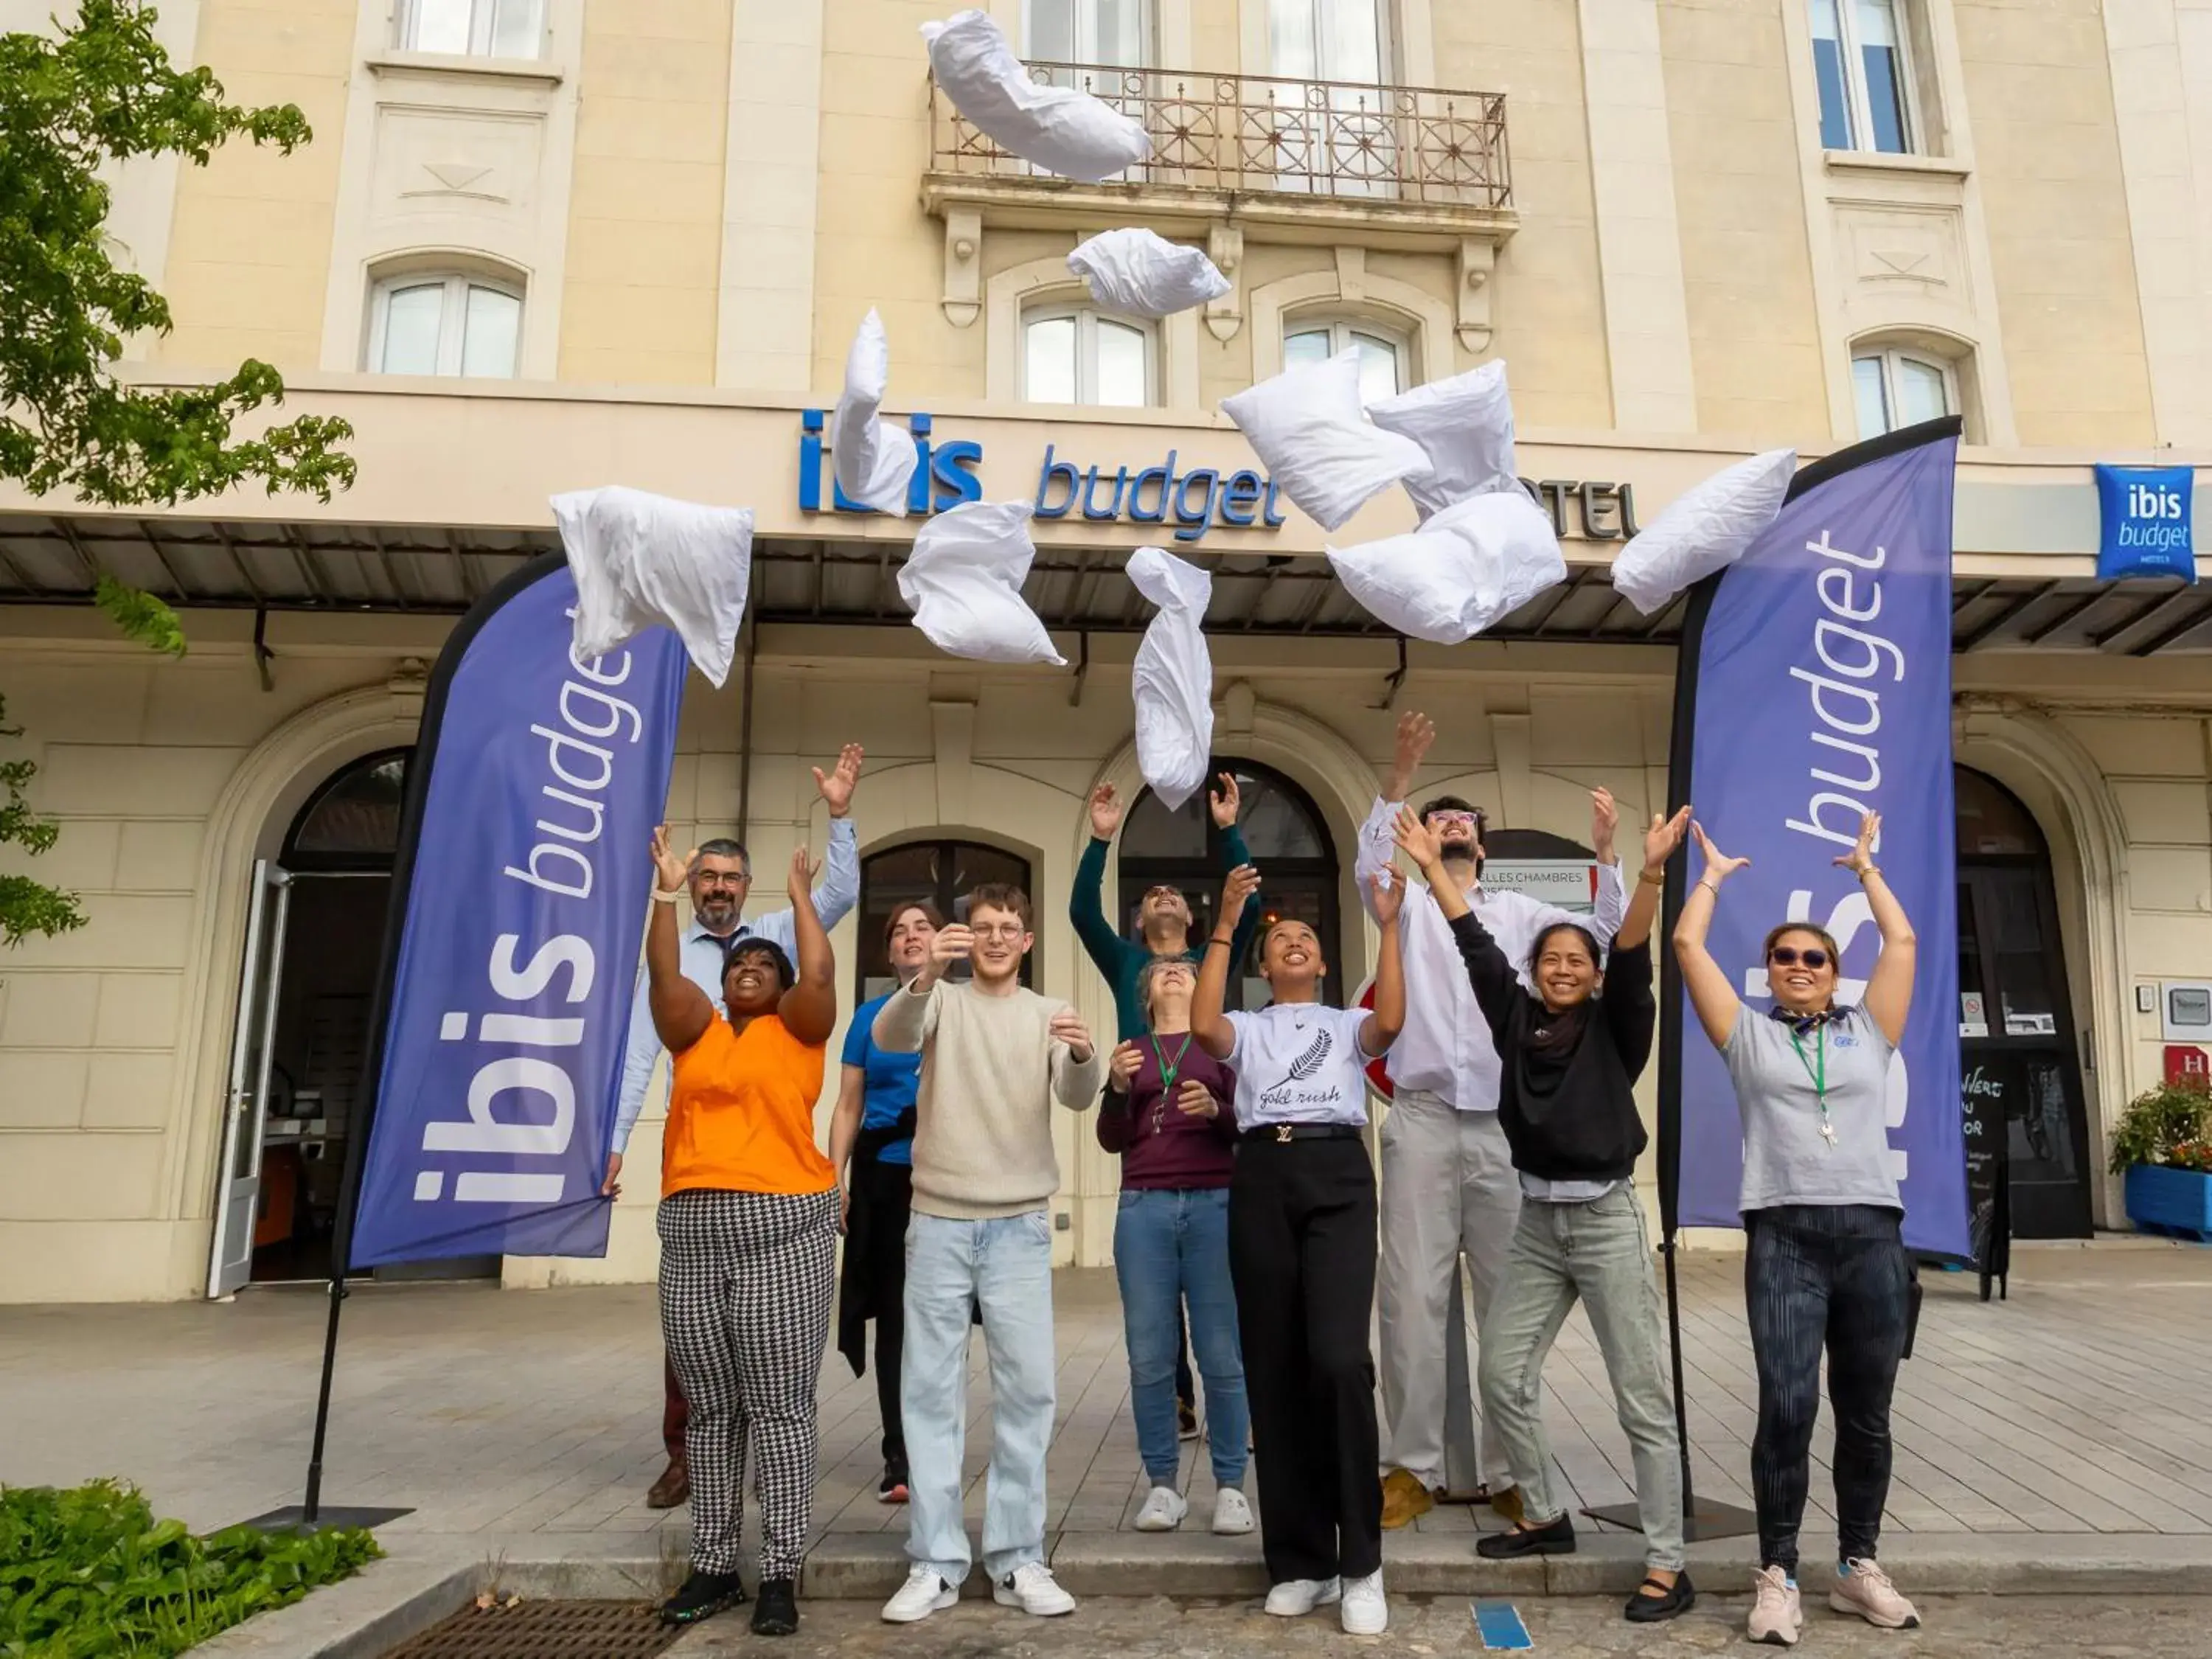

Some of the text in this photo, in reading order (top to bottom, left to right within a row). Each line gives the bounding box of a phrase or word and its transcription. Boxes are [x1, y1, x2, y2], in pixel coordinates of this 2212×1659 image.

[799, 408, 1642, 541] iis budget TEL
[2129, 484, 2182, 519] ibis
[2118, 521, 2189, 552] budget
[1785, 530, 1905, 854] budget
[1479, 872, 1583, 883] ELLES CHAMBRES
[414, 607, 642, 1203] ibis budge
[1260, 1085, 1341, 1110] gold rush
